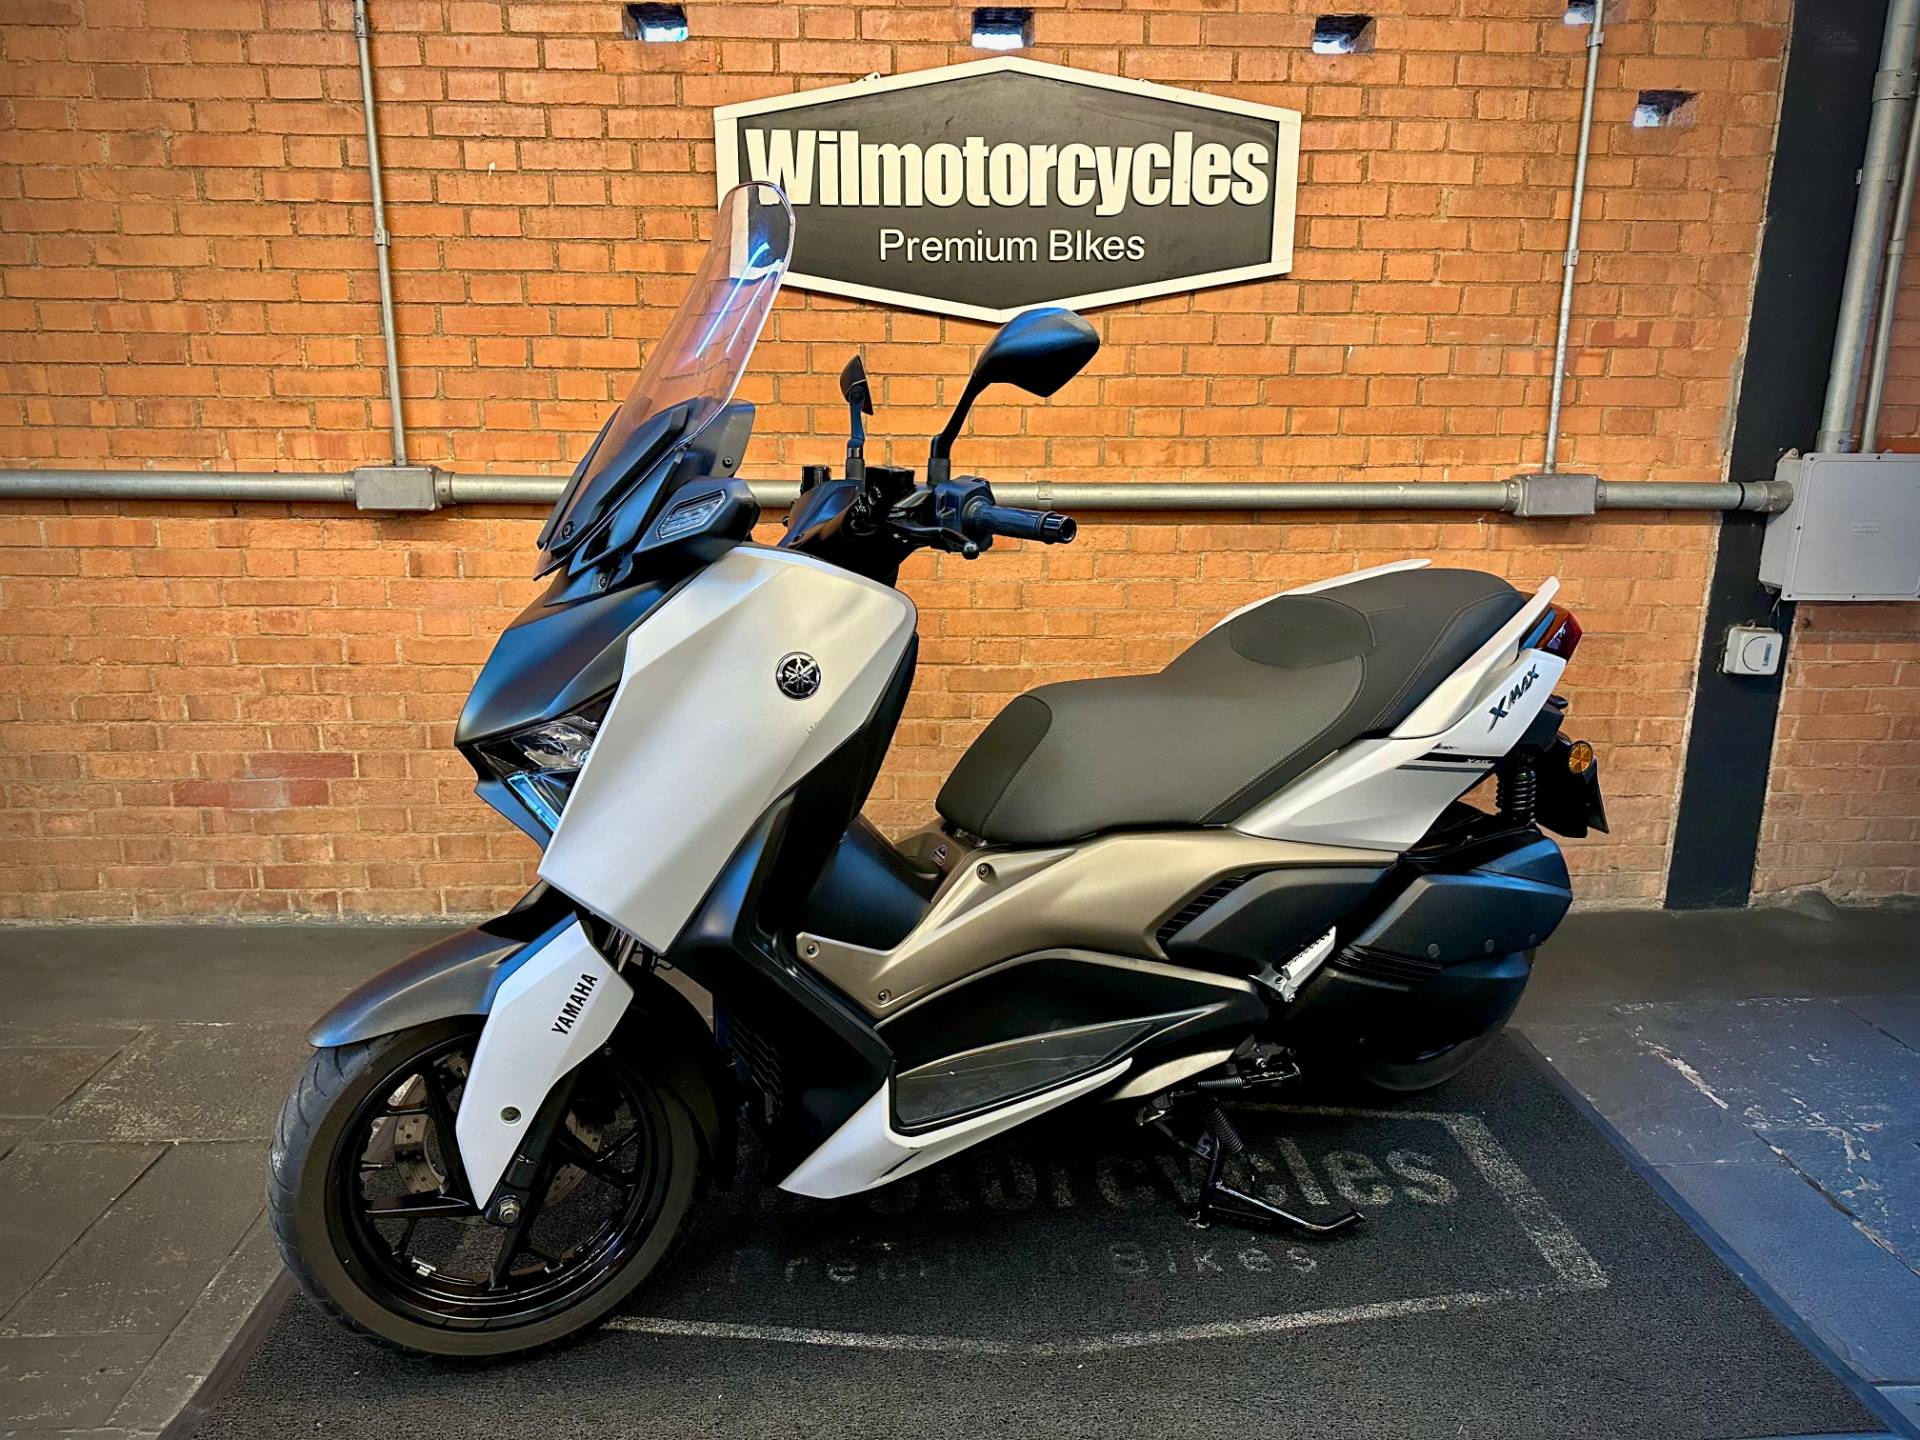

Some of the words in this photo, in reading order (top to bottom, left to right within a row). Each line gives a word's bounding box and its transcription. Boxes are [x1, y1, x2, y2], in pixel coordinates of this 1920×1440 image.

[745, 128, 1269, 216] Wilmotorcycles
[879, 228, 1038, 262] Premium
[551, 973, 598, 1035] YAMAHA
